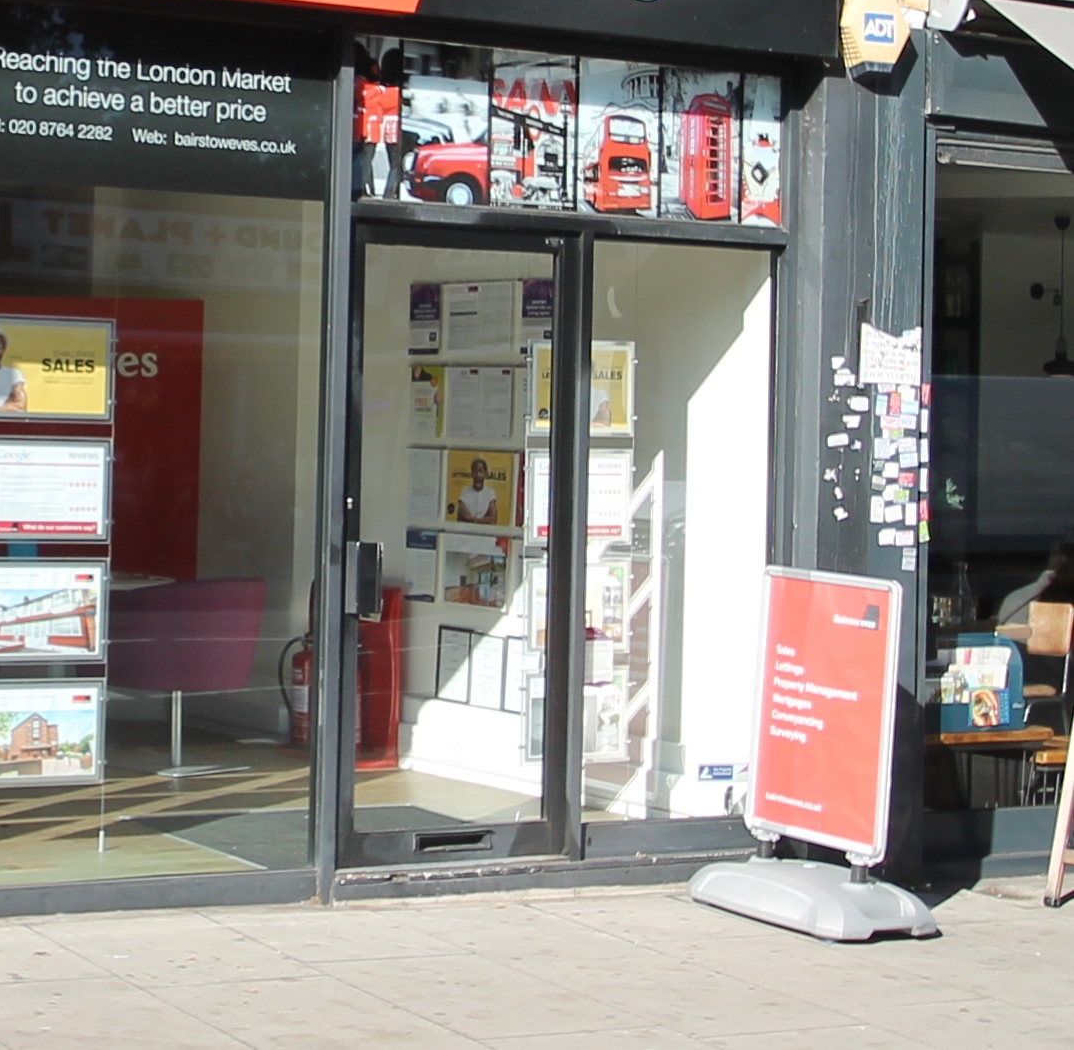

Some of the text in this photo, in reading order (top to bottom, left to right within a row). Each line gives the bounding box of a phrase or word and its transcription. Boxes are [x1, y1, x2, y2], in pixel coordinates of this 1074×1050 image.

[864, 17, 894, 39] ADT
[96, 57, 131, 79] the
[137, 59, 215, 86] London
[221, 67, 292, 93] Market
[14, 81, 267, 123] to achieve a better price
[8, 119, 37, 135] 020
[39, 121, 74, 138] 8764
[77, 124, 113, 141] 2282
[131, 127, 297, 155] Web: bairstoweves.co.uk
[41, 358, 95, 374] SALES
[776, 644, 796, 657] Sales
[775, 660, 804, 676] Lettings
[773, 676, 858, 701] Property Management
[772, 693, 812, 710] Mortgages
[771, 709, 824, 730] Conveyancing
[769, 725, 807, 744] Surveying
